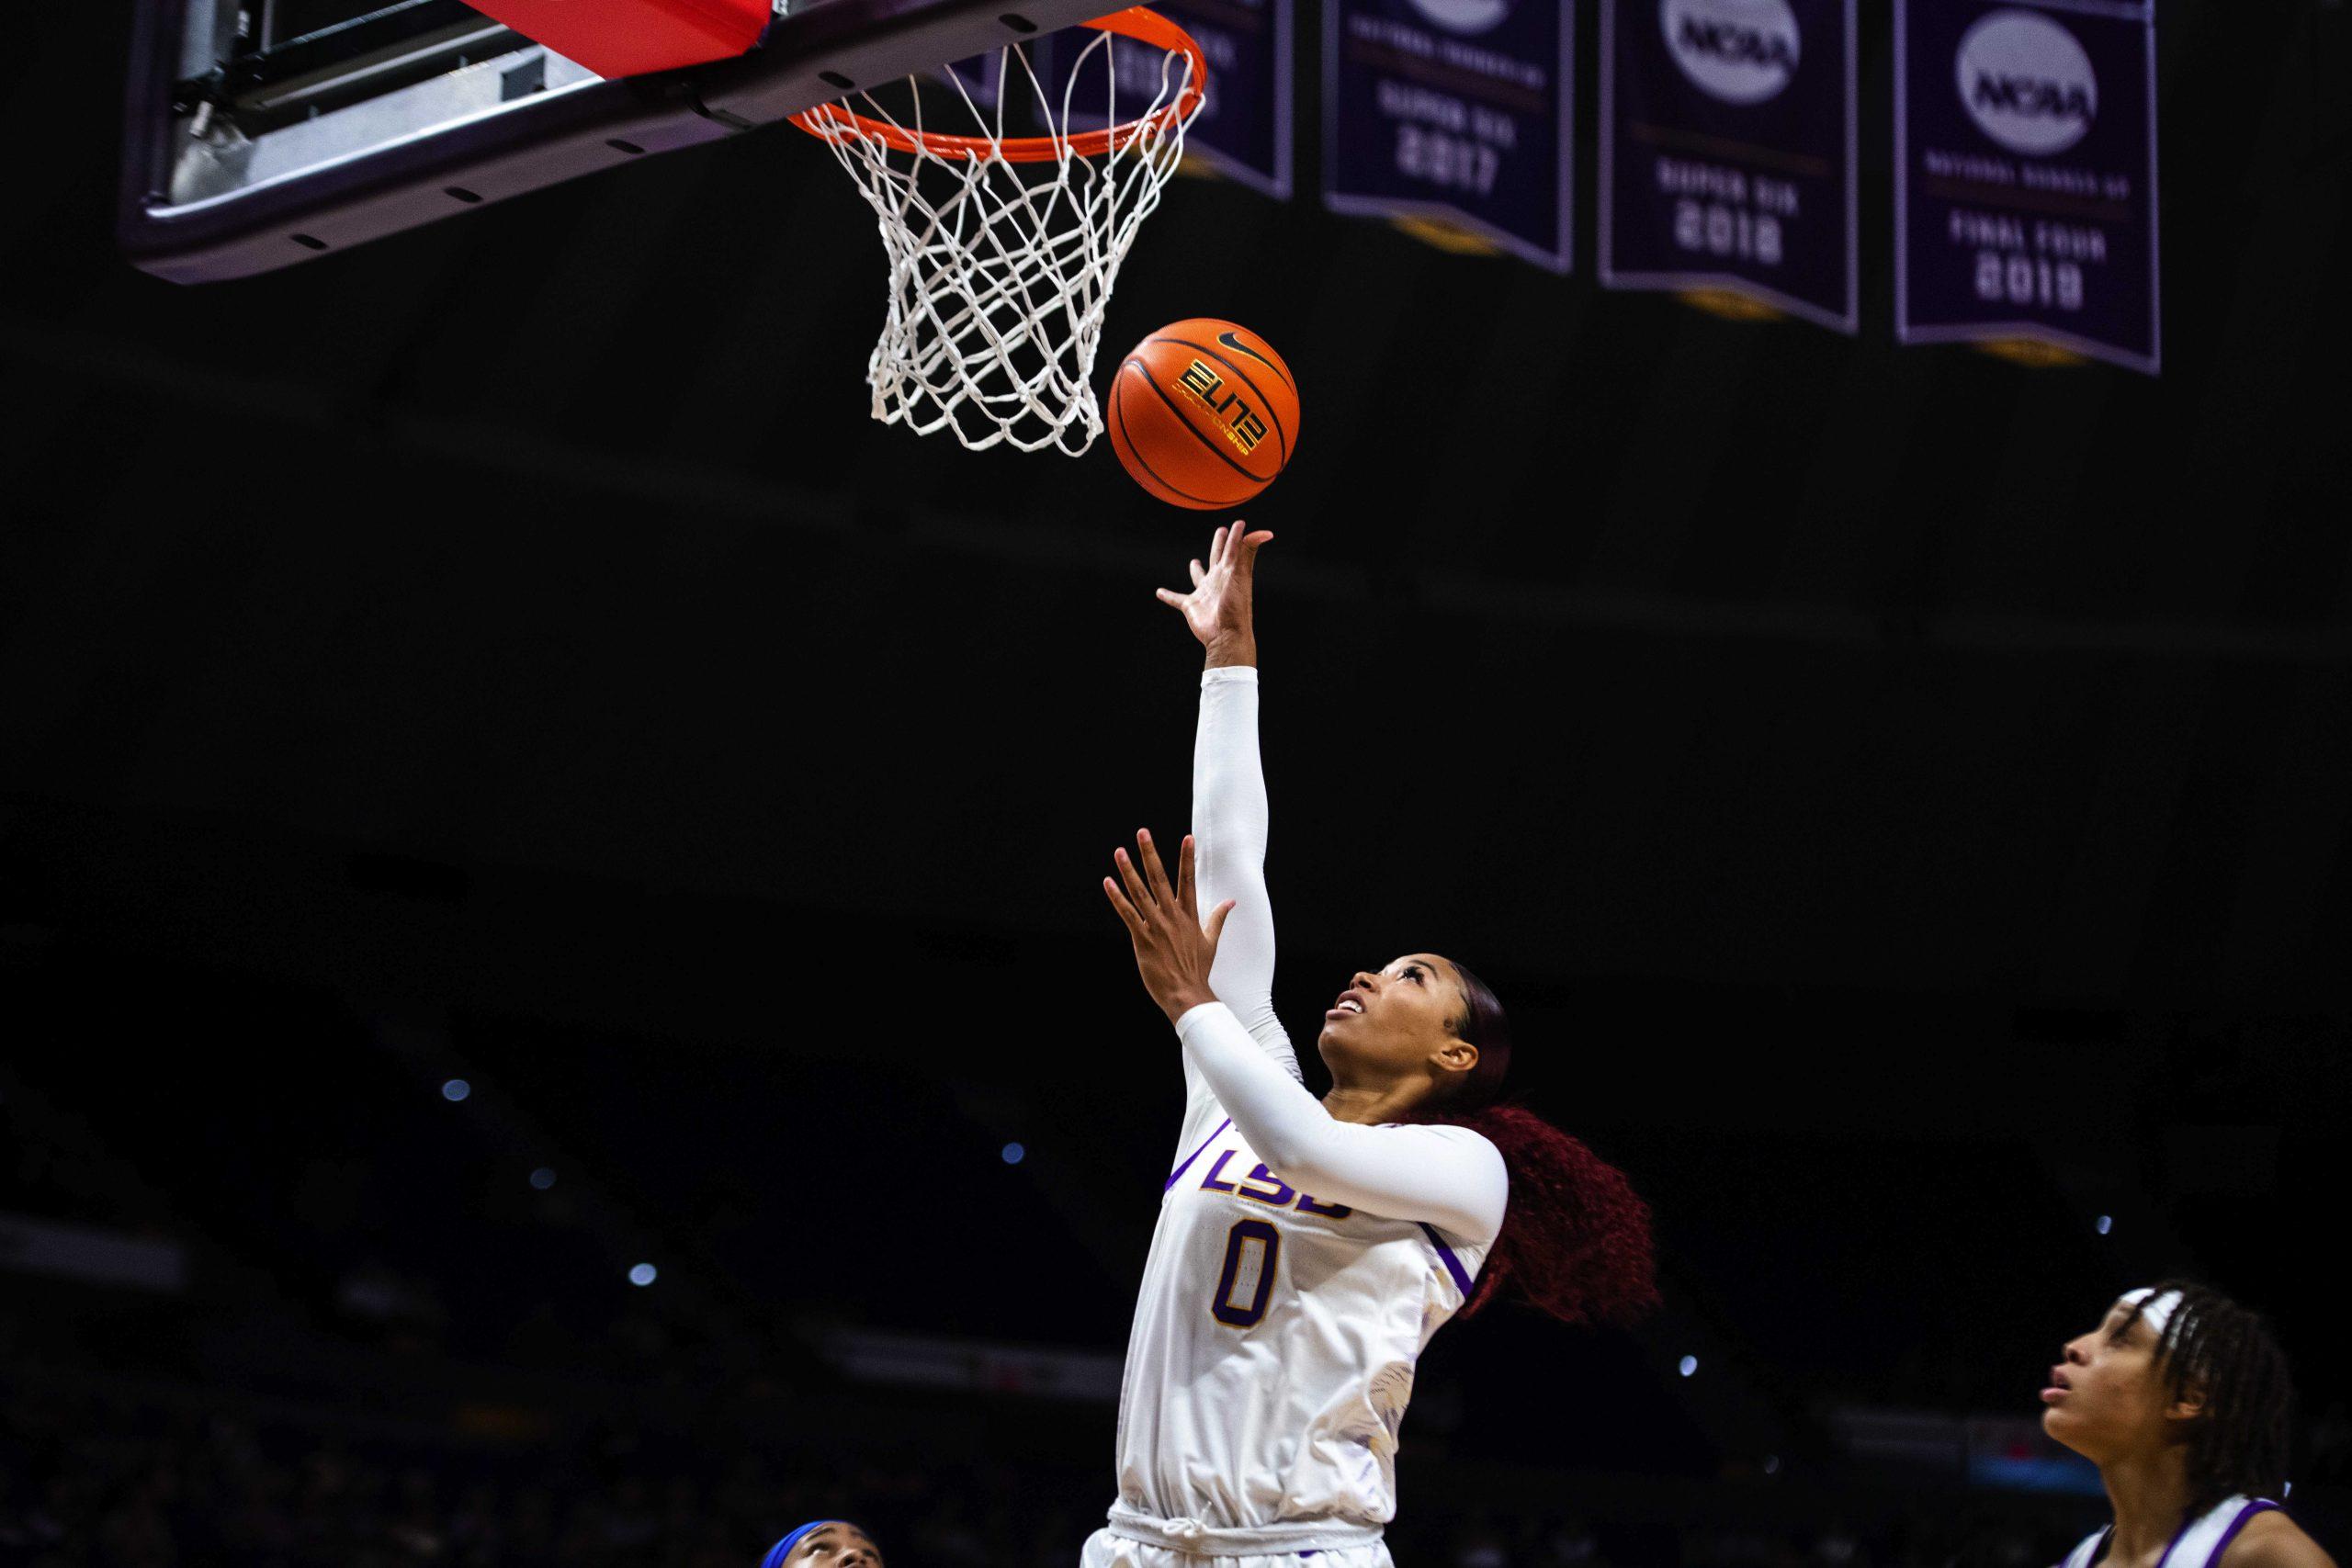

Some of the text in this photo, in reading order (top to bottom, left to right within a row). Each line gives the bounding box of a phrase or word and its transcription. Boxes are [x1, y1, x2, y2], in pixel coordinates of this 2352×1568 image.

[1679, 14, 1797, 68] NCAA
[1975, 72, 2098, 128] NCAA
[1396, 123, 1499, 196] 2017
[1657, 155, 1798, 219] SUPER SIX
[1674, 197, 1783, 266] 2018
[1949, 208, 2108, 265] FINAL FOUR
[1975, 249, 2084, 310] 2019
[1177, 357, 1269, 451] ELITE
[1211, 1217, 1280, 1329] 0
